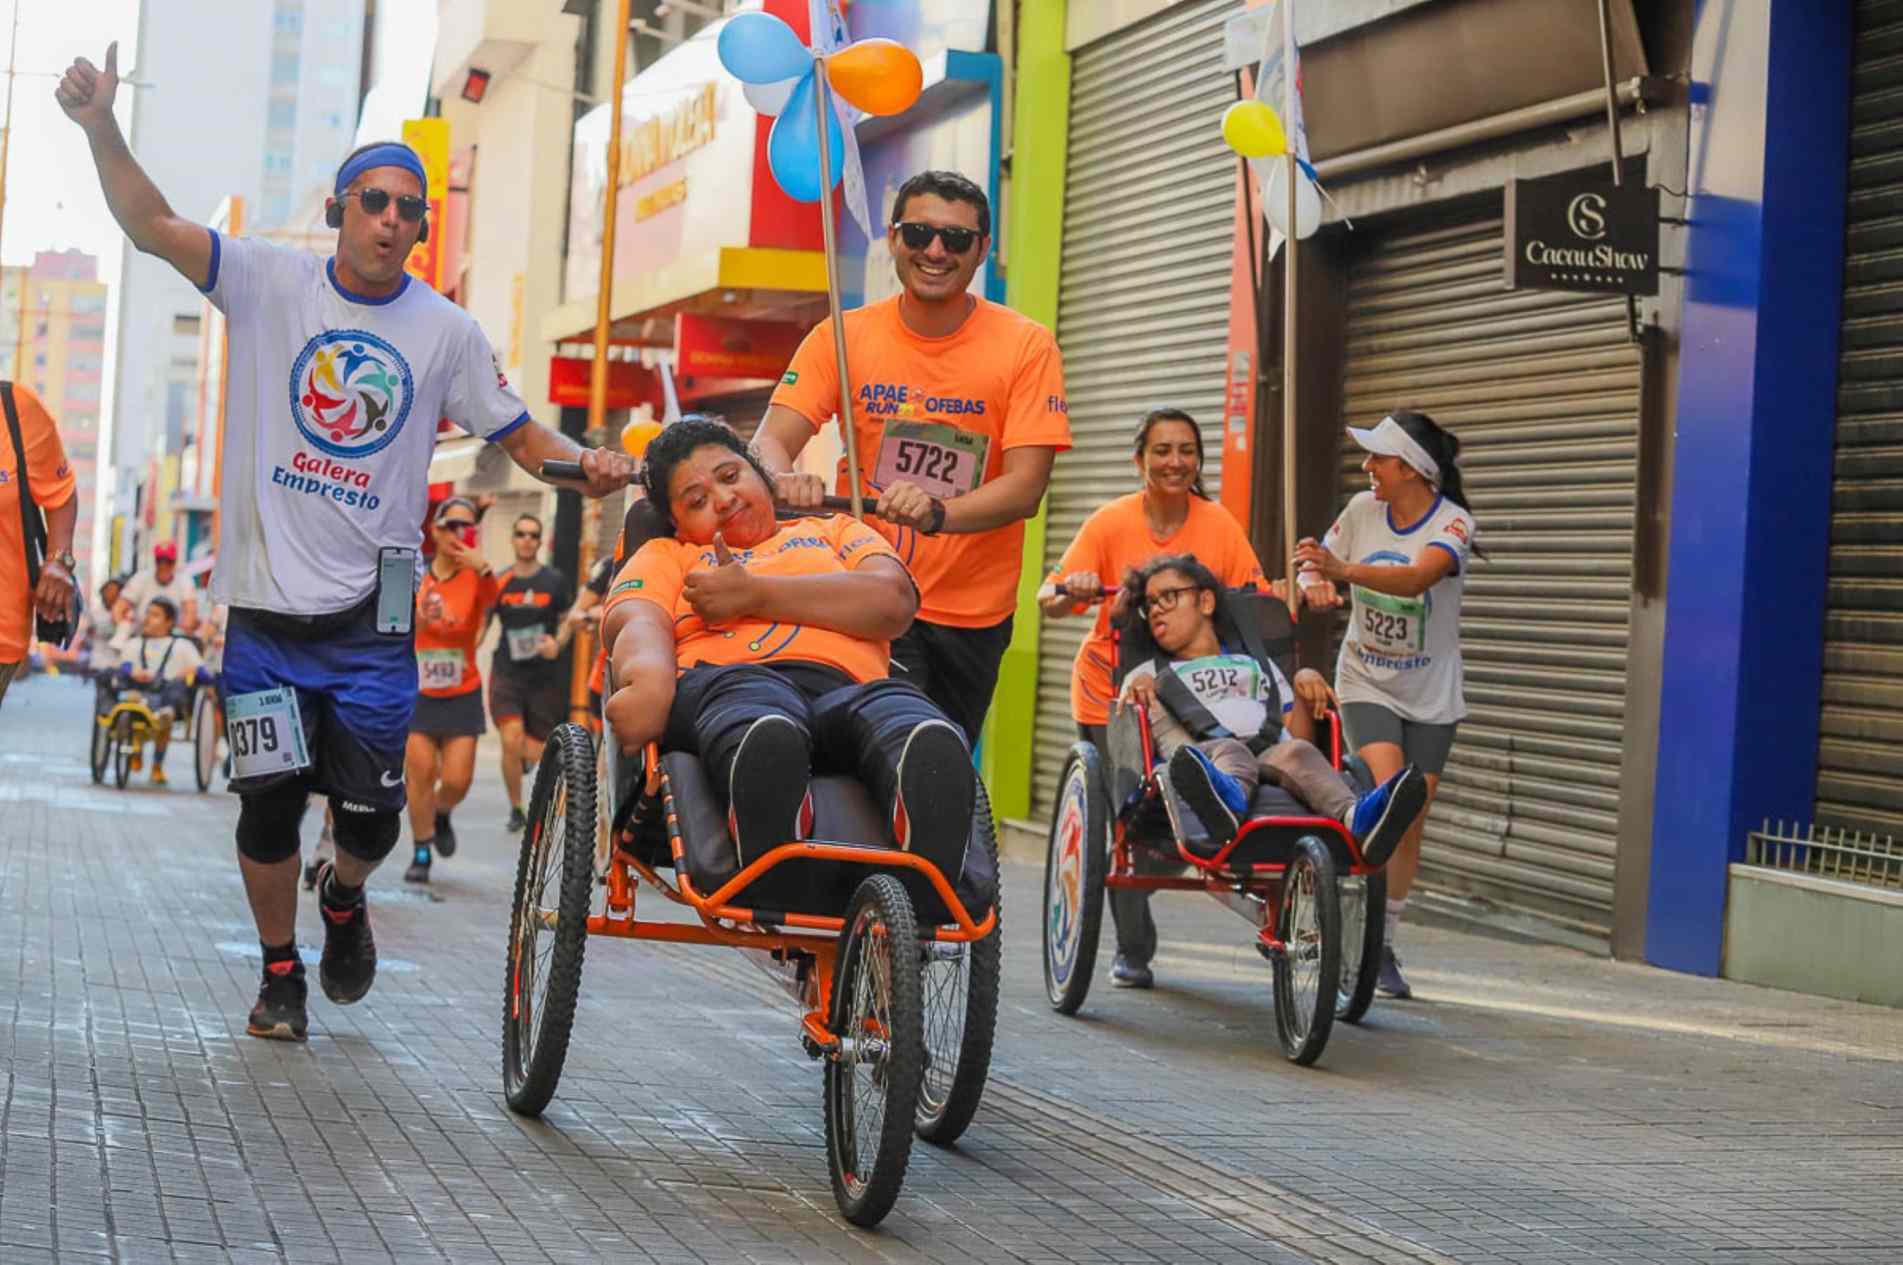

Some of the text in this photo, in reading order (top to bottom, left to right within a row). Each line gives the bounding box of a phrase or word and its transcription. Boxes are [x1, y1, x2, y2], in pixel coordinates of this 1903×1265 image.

[860, 384, 908, 403] APAE
[925, 397, 985, 415] OFEBAS
[865, 401, 899, 414] RUN
[292, 452, 371, 488] Galera
[896, 441, 958, 484] 5722
[271, 466, 380, 510] Empresto
[1365, 608, 1407, 640] 5223
[1191, 669, 1238, 692] 5212
